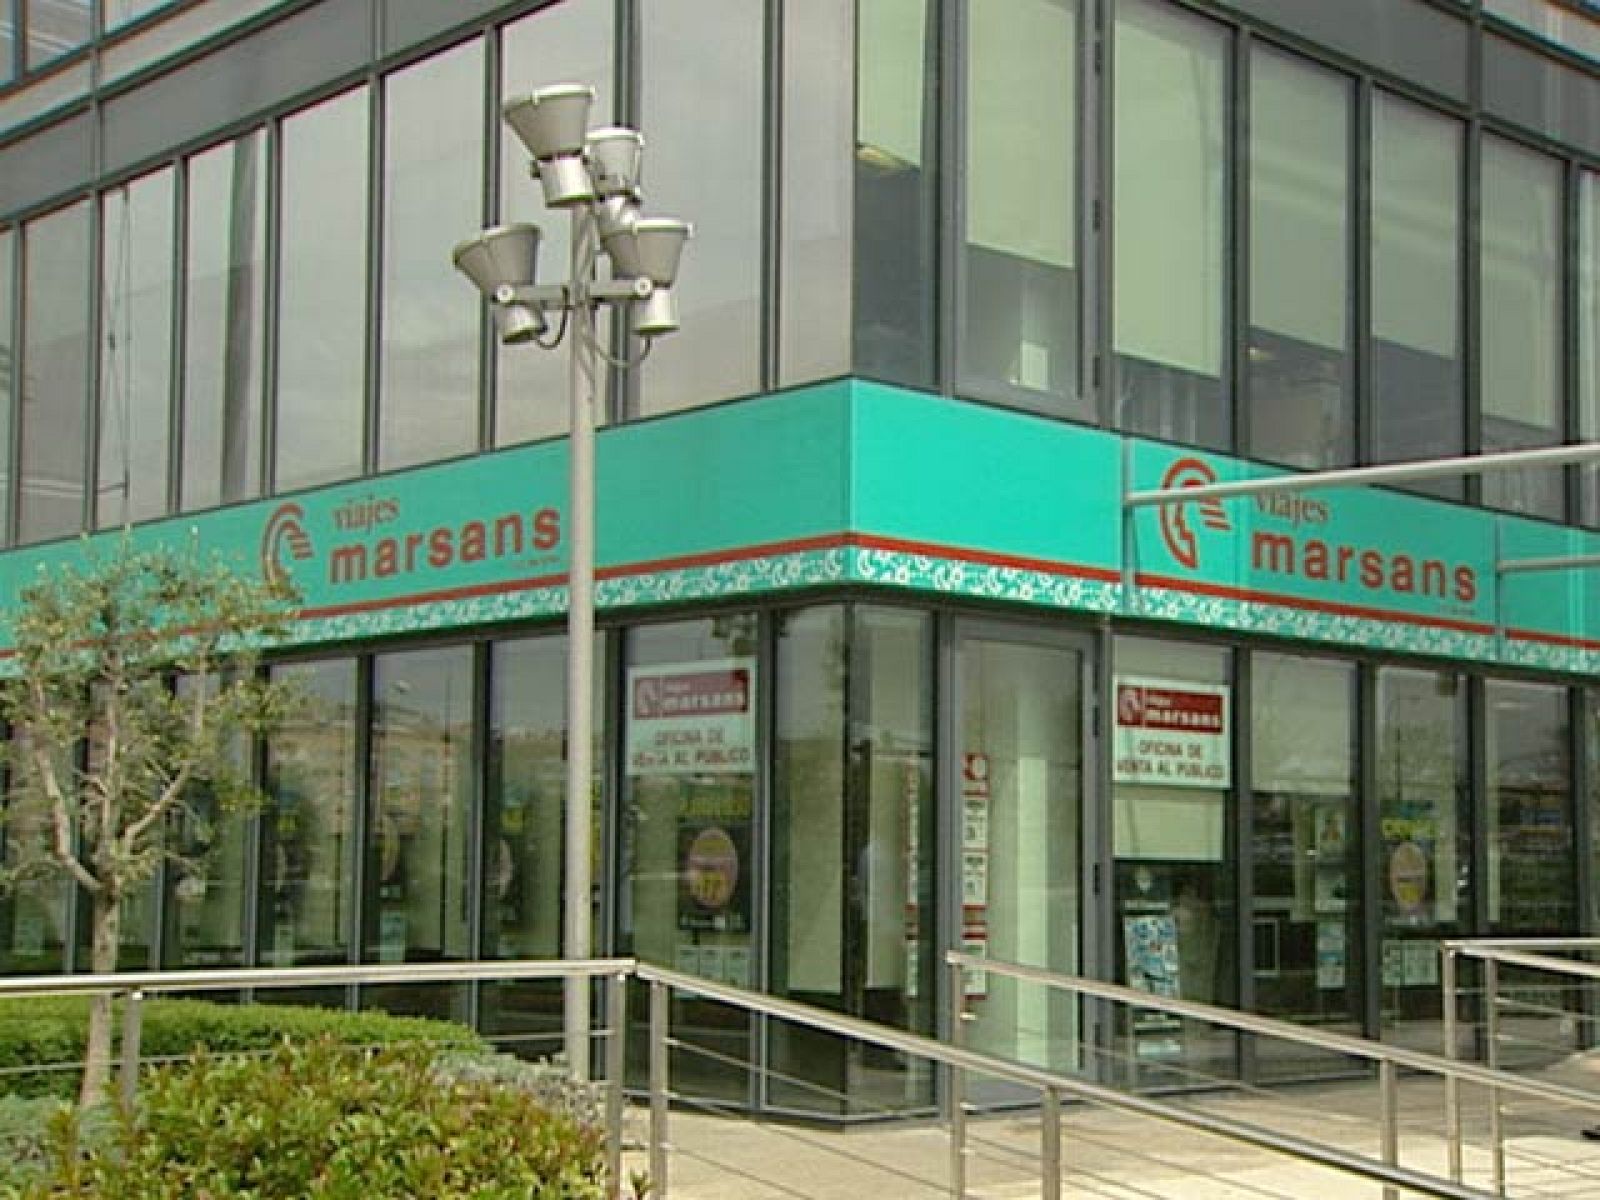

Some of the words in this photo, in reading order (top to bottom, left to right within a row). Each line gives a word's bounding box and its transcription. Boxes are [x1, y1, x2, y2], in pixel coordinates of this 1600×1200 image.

[332, 494, 399, 534] viajes
[329, 507, 561, 584] marsans
[1252, 530, 1477, 602] marsans
[1144, 708, 1222, 729] marsans
